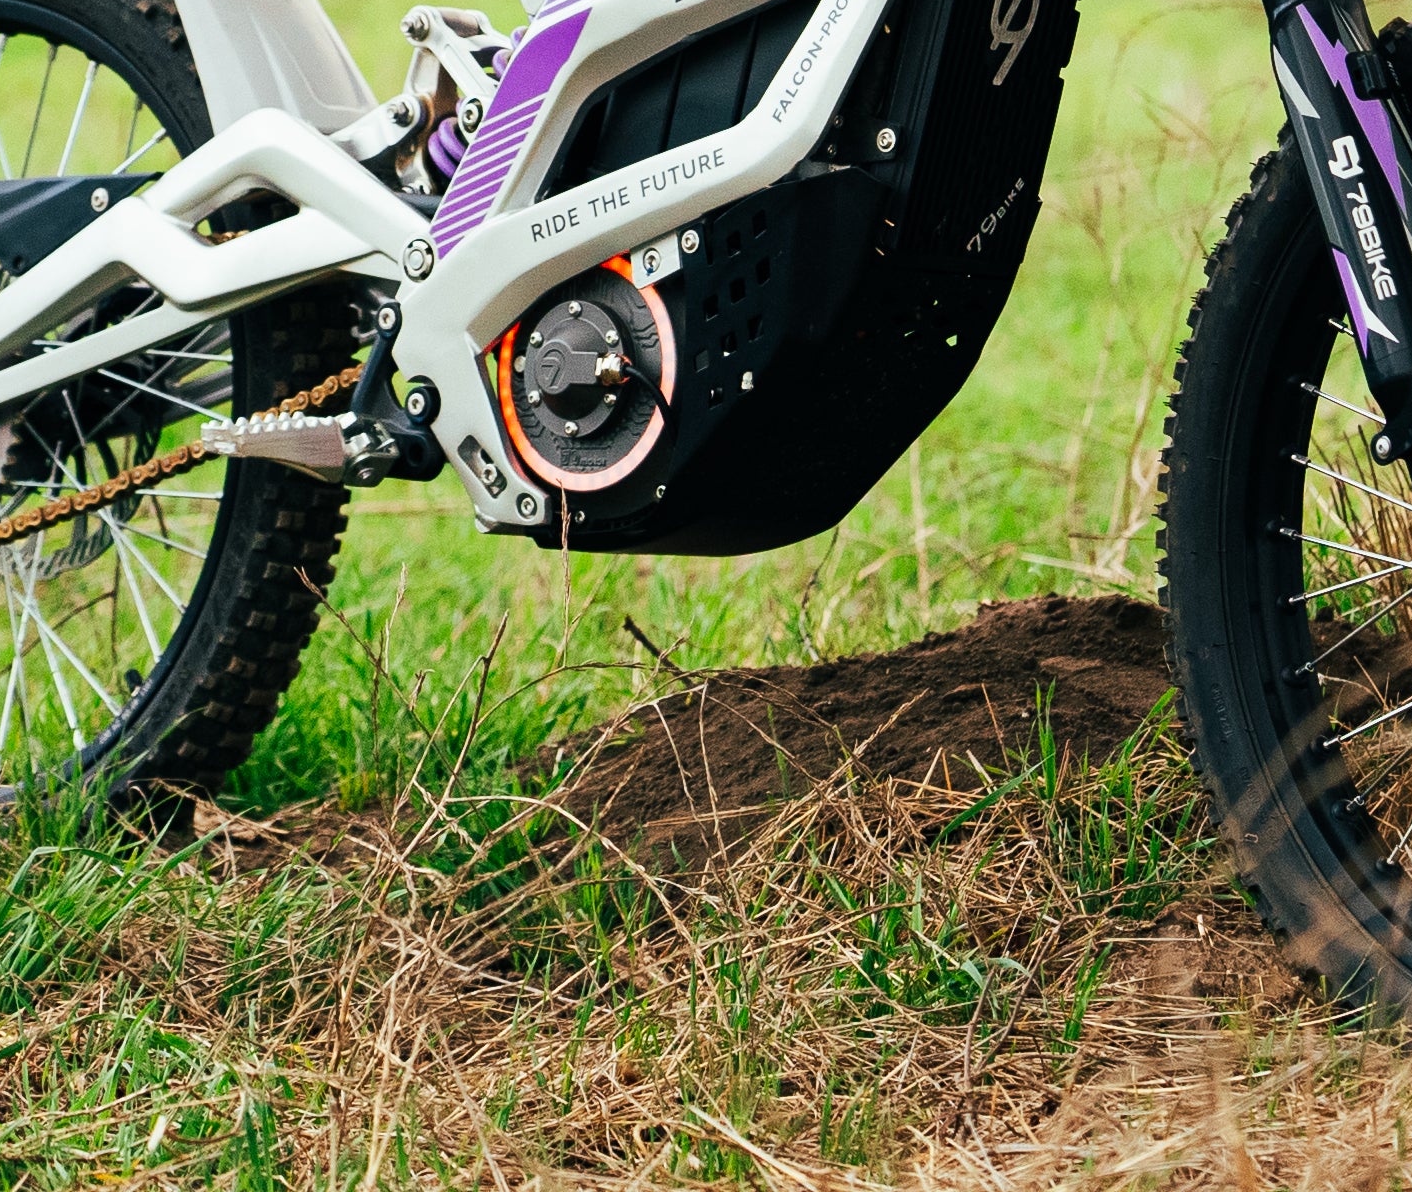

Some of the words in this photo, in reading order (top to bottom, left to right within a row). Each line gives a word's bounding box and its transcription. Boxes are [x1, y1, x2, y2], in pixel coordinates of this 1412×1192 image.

[530, 207, 580, 242] RIDE
[588, 186, 630, 218] THE
[640, 147, 725, 198] FUTURE
[1346, 182, 1398, 301] 79BIKE
